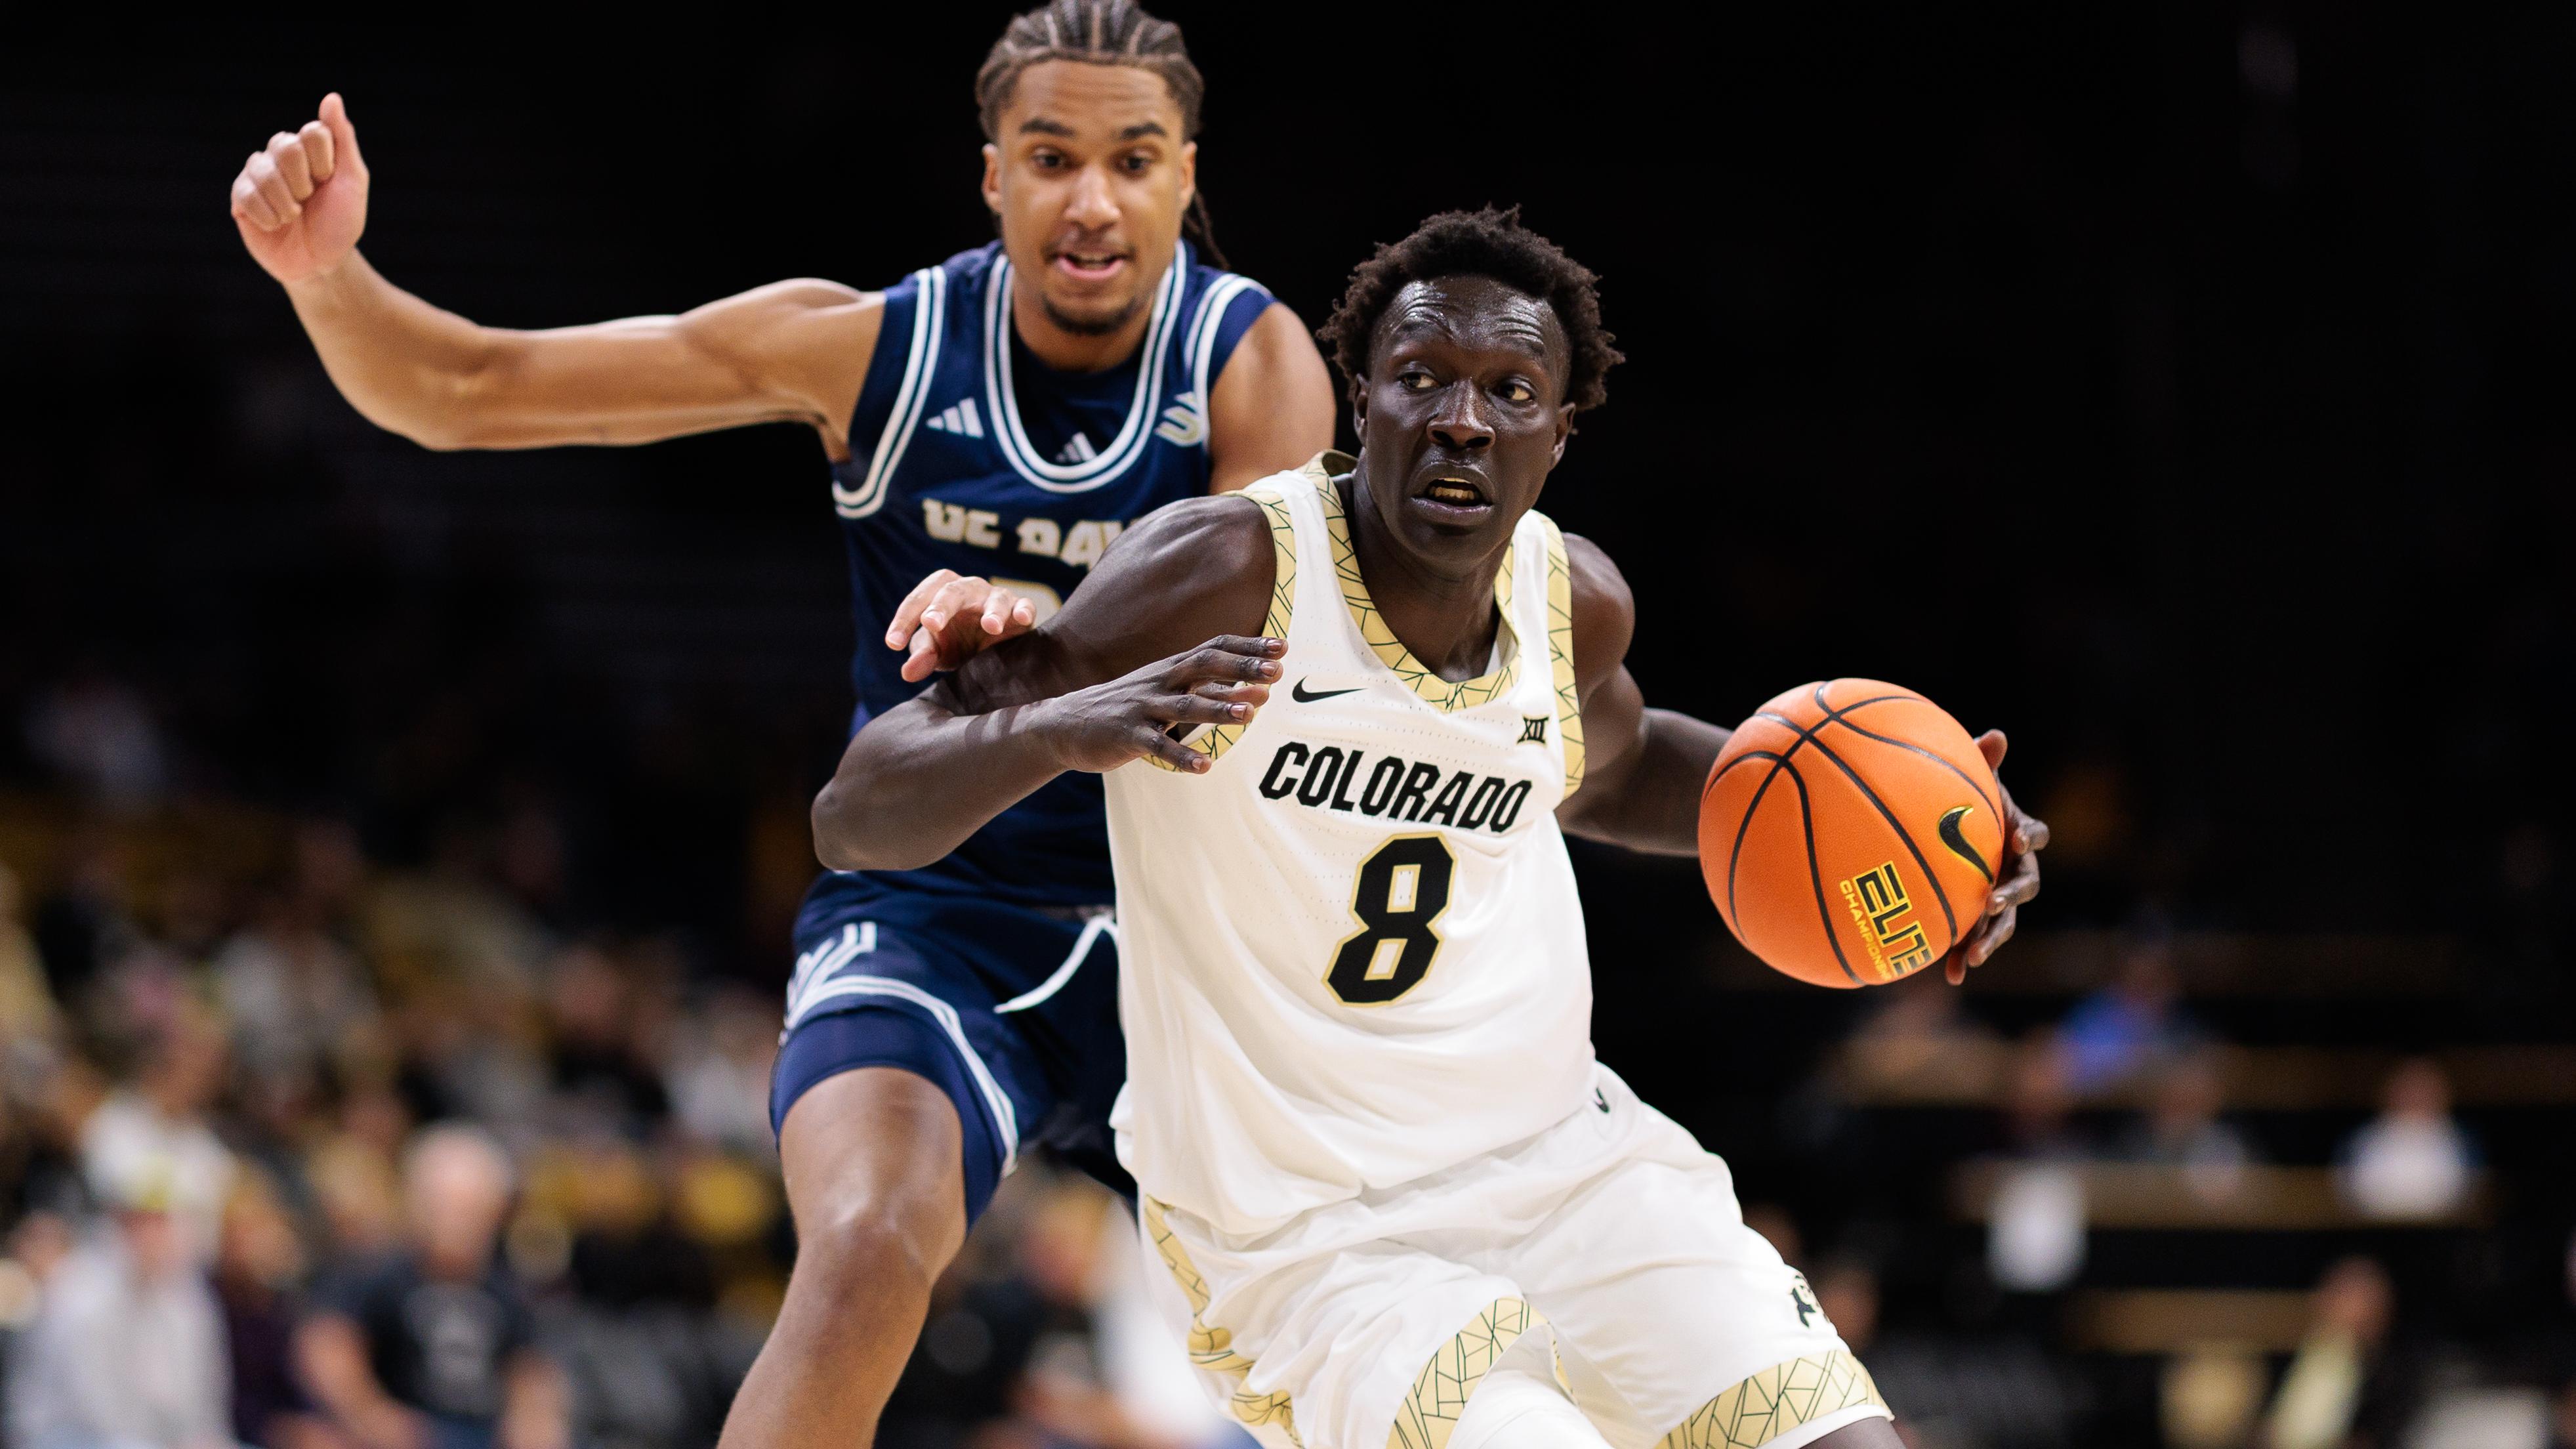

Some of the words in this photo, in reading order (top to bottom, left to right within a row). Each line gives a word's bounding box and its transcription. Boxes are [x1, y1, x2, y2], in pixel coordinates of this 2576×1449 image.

[922, 497, 1001, 549] UC
[1258, 741, 1532, 833] COLORADO
[1321, 831, 1458, 1008] 8
[1852, 860, 1935, 977] ELITE
